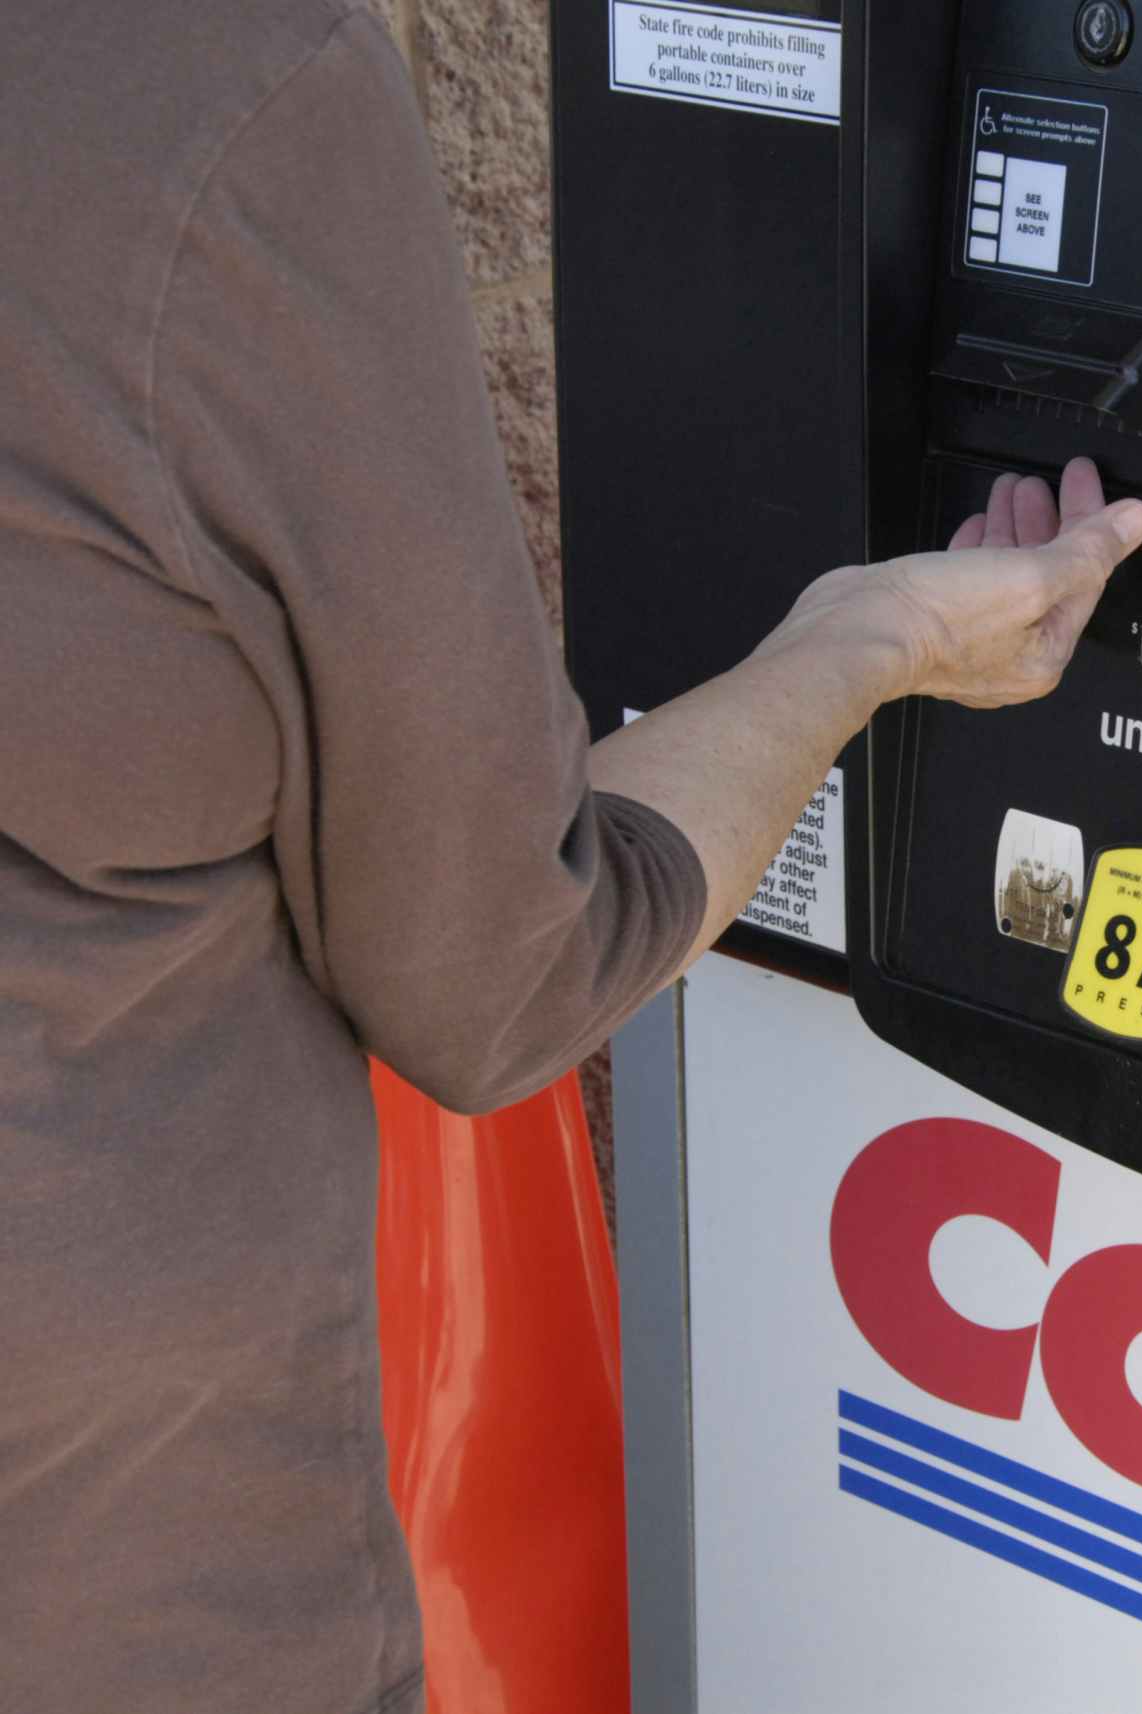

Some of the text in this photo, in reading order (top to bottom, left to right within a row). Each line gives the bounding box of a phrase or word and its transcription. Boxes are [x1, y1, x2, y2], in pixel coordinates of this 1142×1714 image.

[639, 14, 826, 60] State fire code prohibits filling
[657, 41, 806, 77] portable containers over
[649, 63, 815, 103] 6 gallons (22.7 liters) in size
[1025, 193, 1042, 205] SEE
[1015, 207, 1049, 221] SCREEN
[1016, 222, 1045, 236] ABOVE
[786, 845, 827, 868] adjust
[780, 861, 815, 882] other
[779, 879, 817, 901] affect
[752, 891, 807, 916] ntent of
